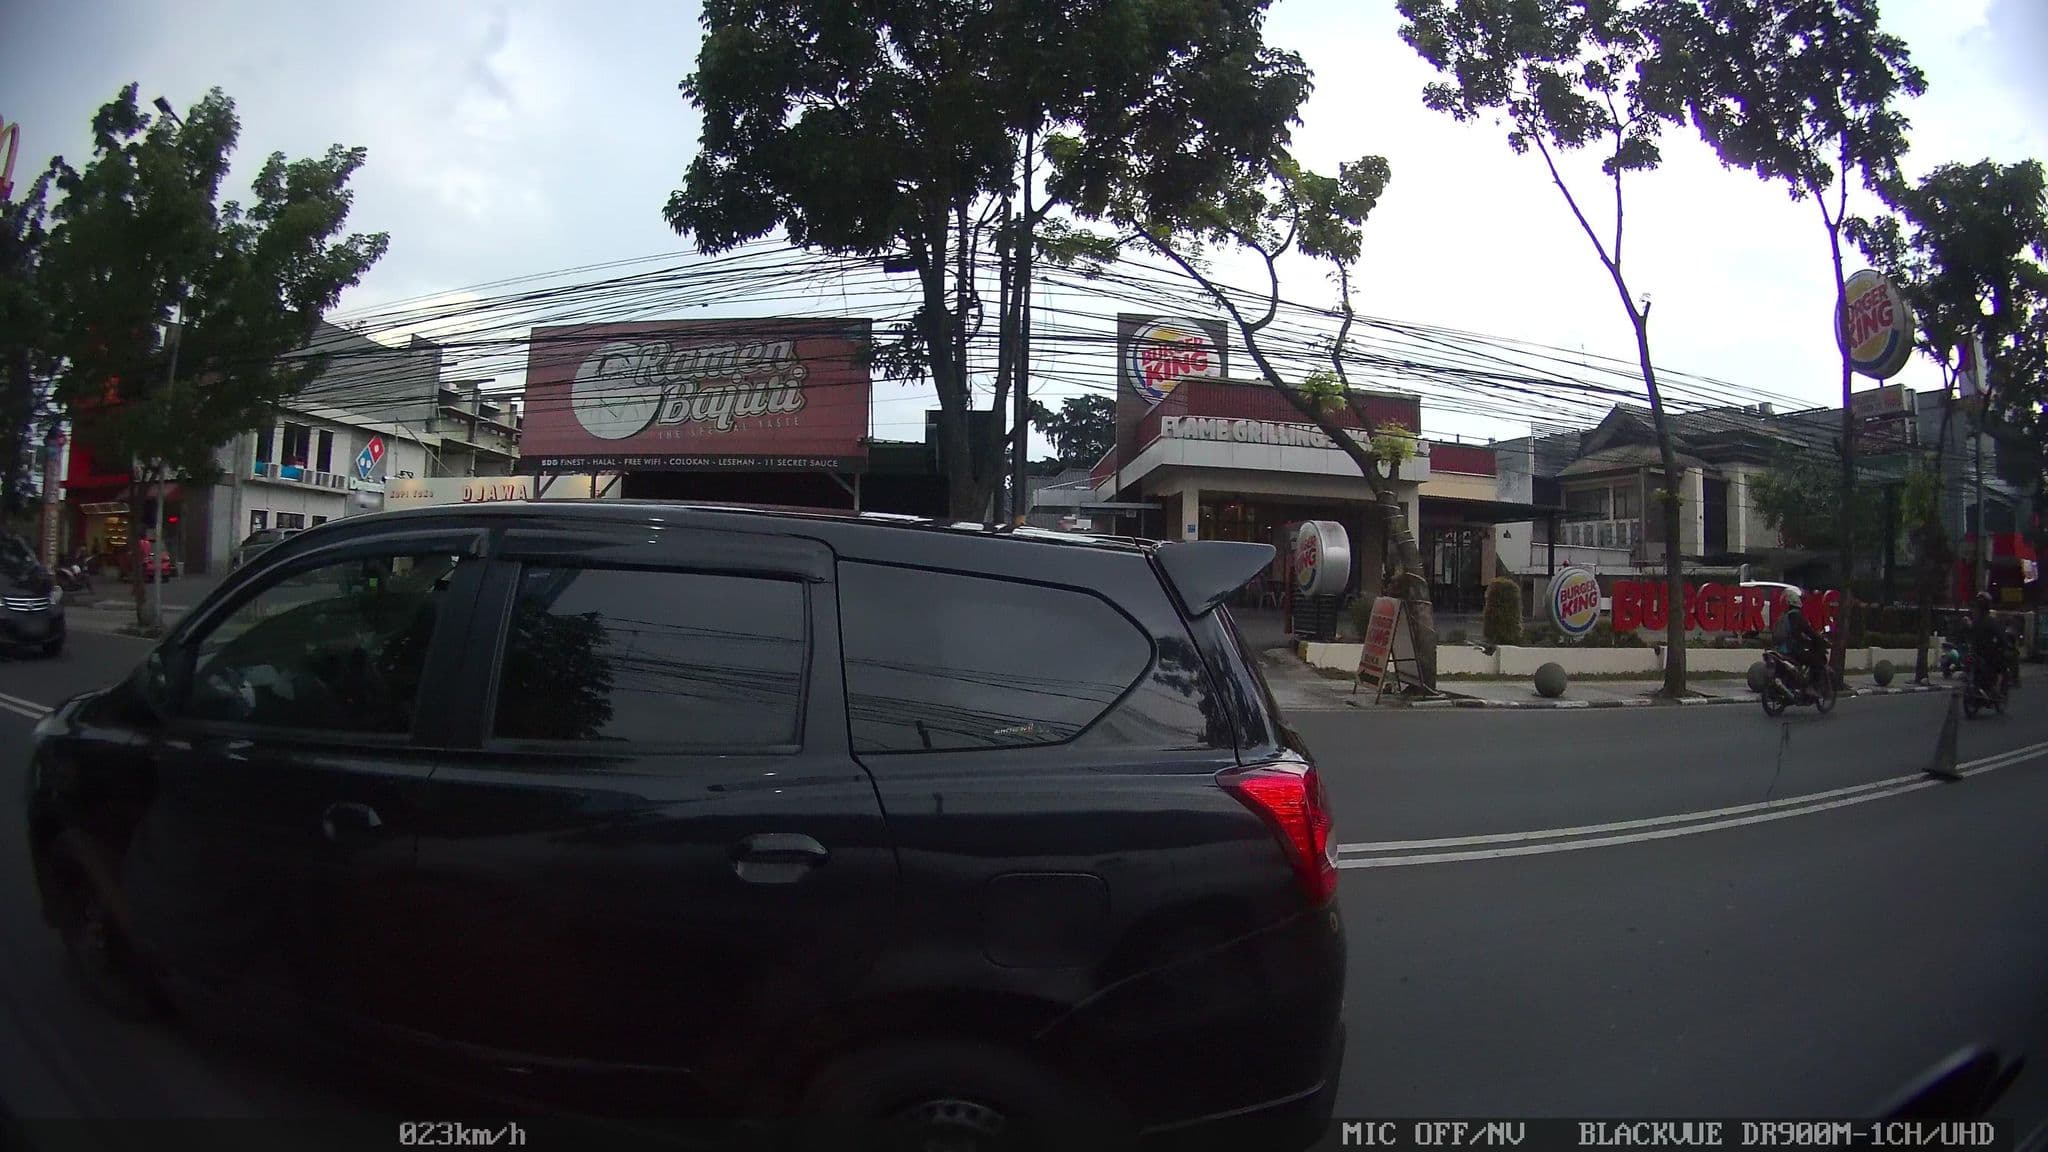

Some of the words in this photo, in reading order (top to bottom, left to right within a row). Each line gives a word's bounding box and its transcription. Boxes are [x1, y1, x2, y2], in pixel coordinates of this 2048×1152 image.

[635, 340, 800, 386] Ramen
[1146, 352, 1208, 386] KING
[658, 431, 681, 440] THE
[690, 422, 747, 437] SPEAL
[759, 417, 799, 428] TASTE
[1161, 416, 1229, 441] FLAME
[1232, 420, 1328, 448] GRILLING
[560, 458, 585, 466] FINEST
[592, 458, 616, 466] HALAL
[624, 458, 641, 466] FREE
[644, 458, 661, 466] WIFI
[669, 458, 710, 466] COLOKAN
[718, 458, 755, 466] LESEHAN
[777, 458, 807, 467] SECRET
[810, 459, 839, 468] SAUCE
[463, 484, 528, 502] DJAWA
[1560, 579, 1597, 602] BURGER
[1561, 590, 1598, 619] KING
